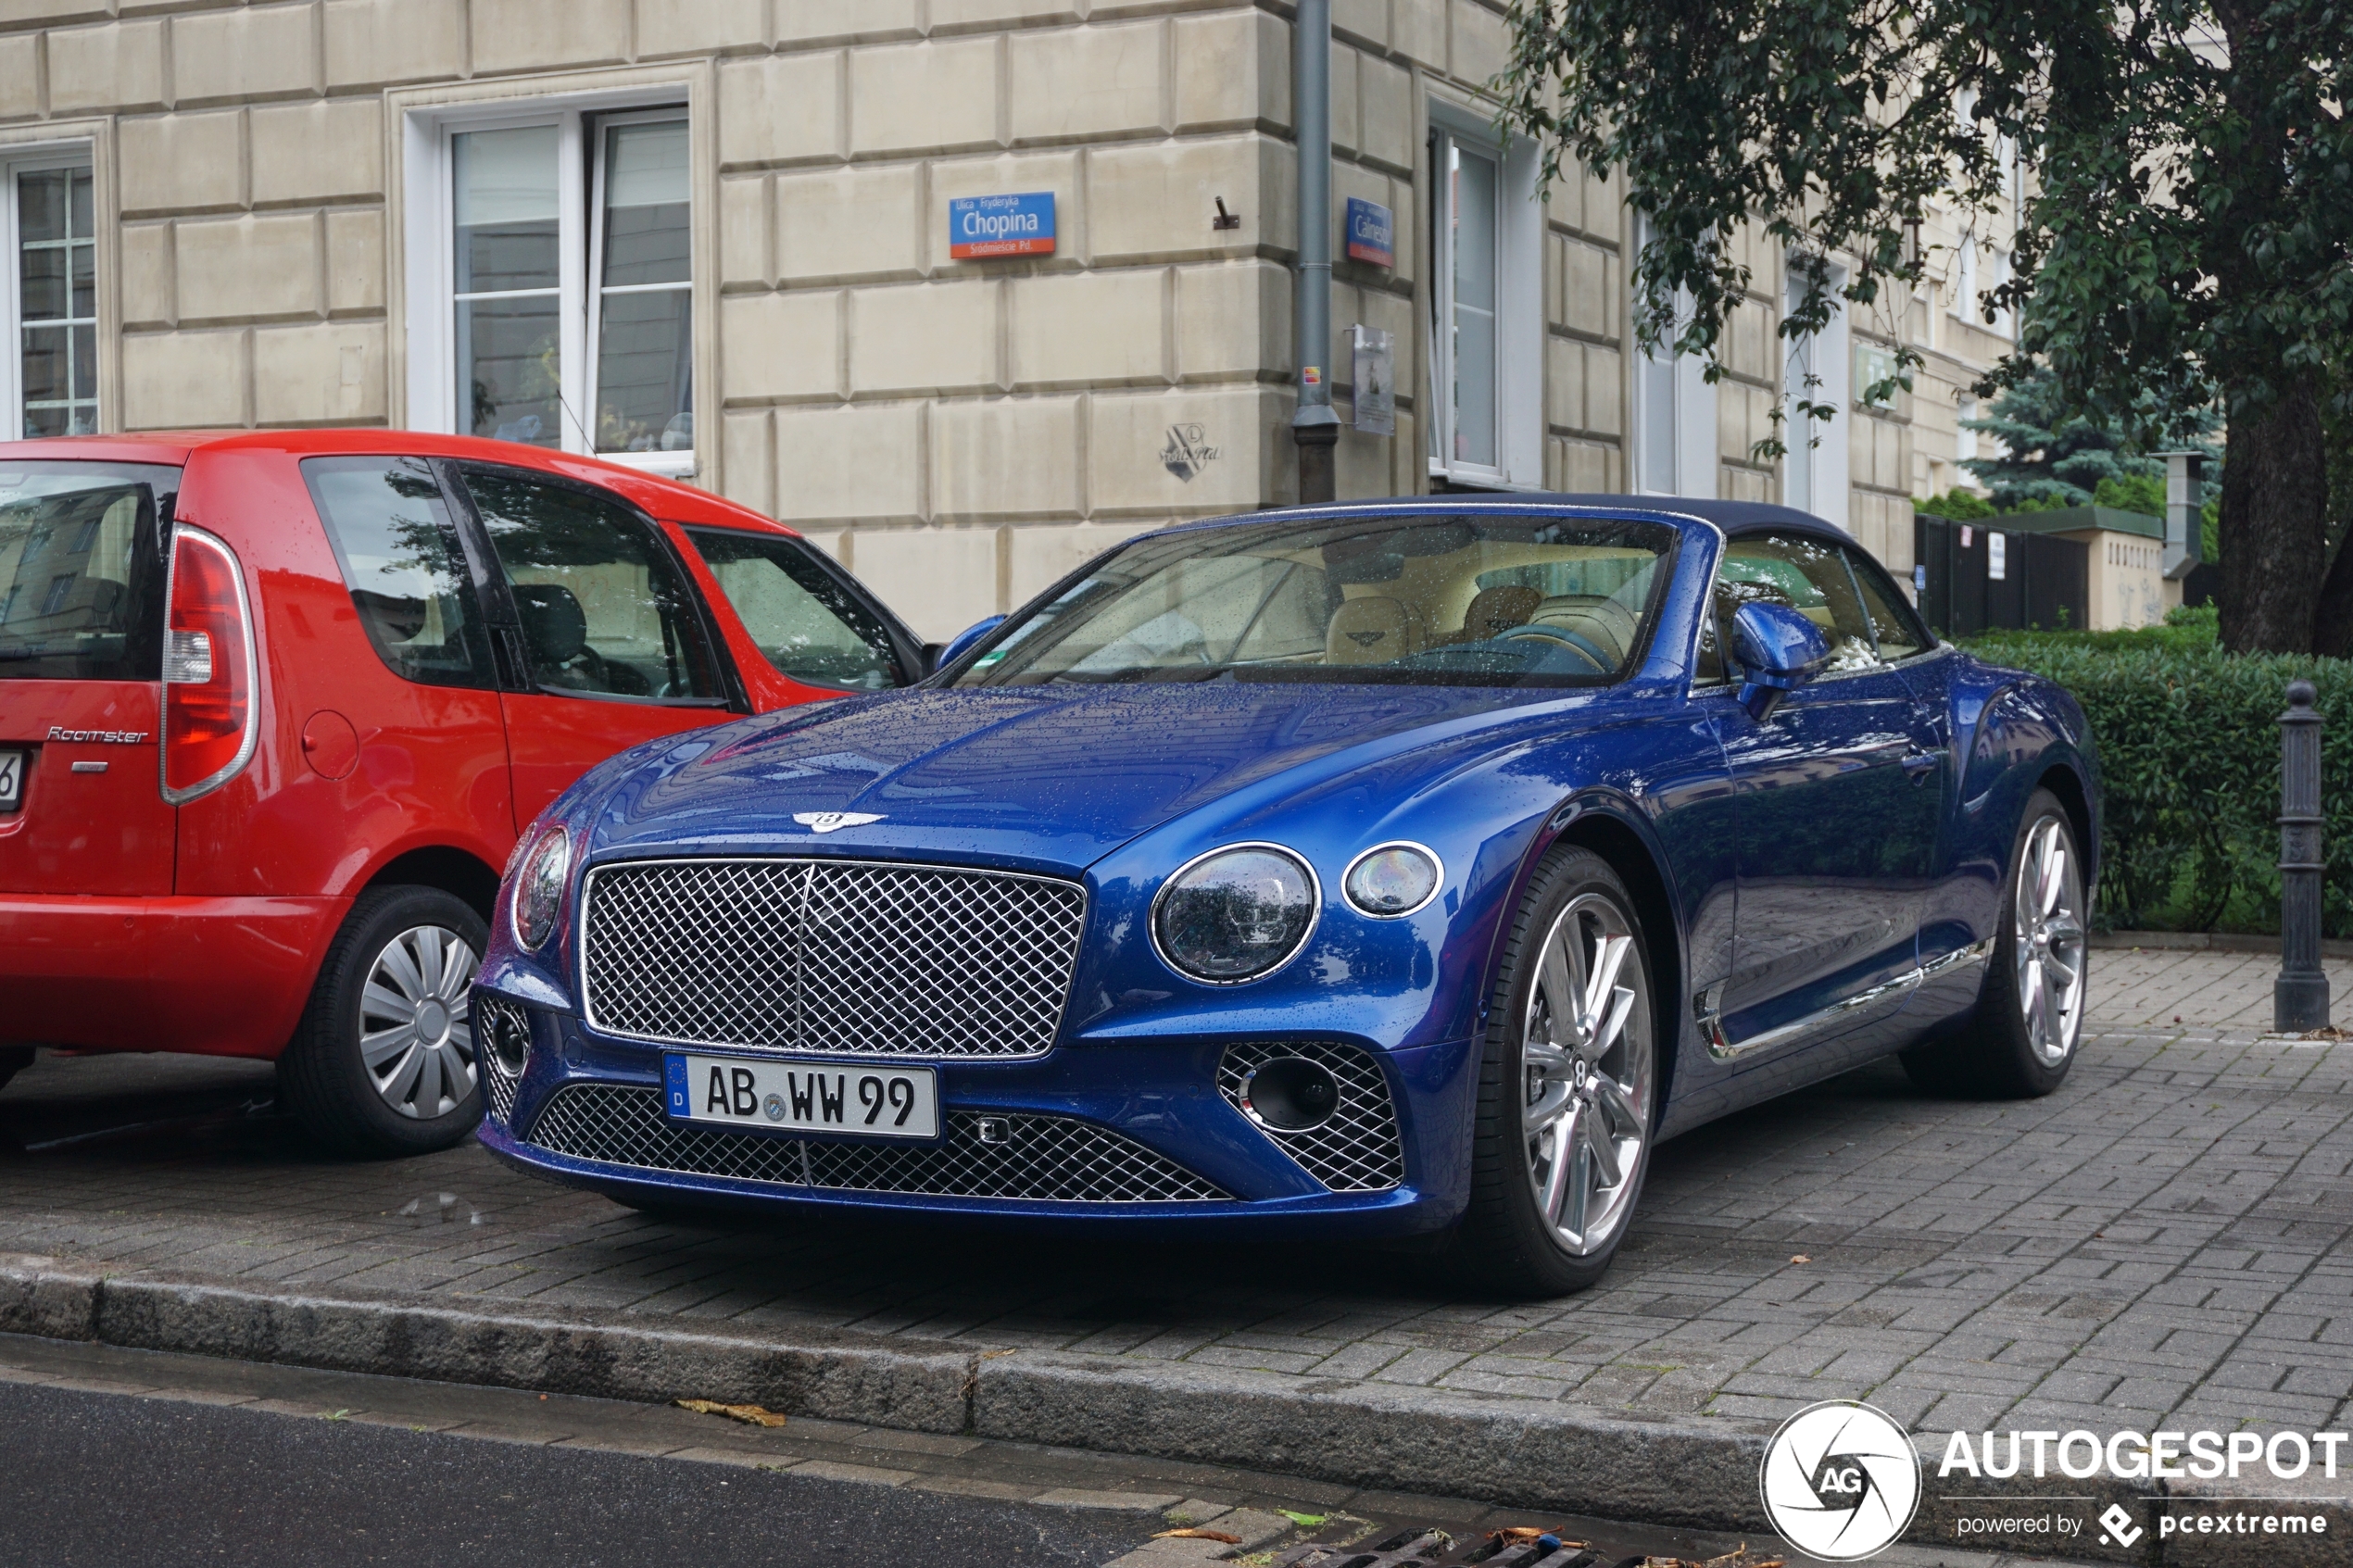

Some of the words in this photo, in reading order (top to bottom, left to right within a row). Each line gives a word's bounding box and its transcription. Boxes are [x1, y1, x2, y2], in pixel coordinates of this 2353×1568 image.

[956, 199, 975, 210] Ulica
[980, 196, 1019, 209] Fryderyka
[963, 208, 1038, 239] Chopina
[971, 242, 1016, 254] Śródmieście
[47, 726, 148, 744] Roomster
[0, 757, 17, 797] 6
[673, 1092, 684, 1106] D
[707, 1065, 758, 1116] AB
[787, 1071, 845, 1123] WW
[858, 1075, 914, 1126] 99
